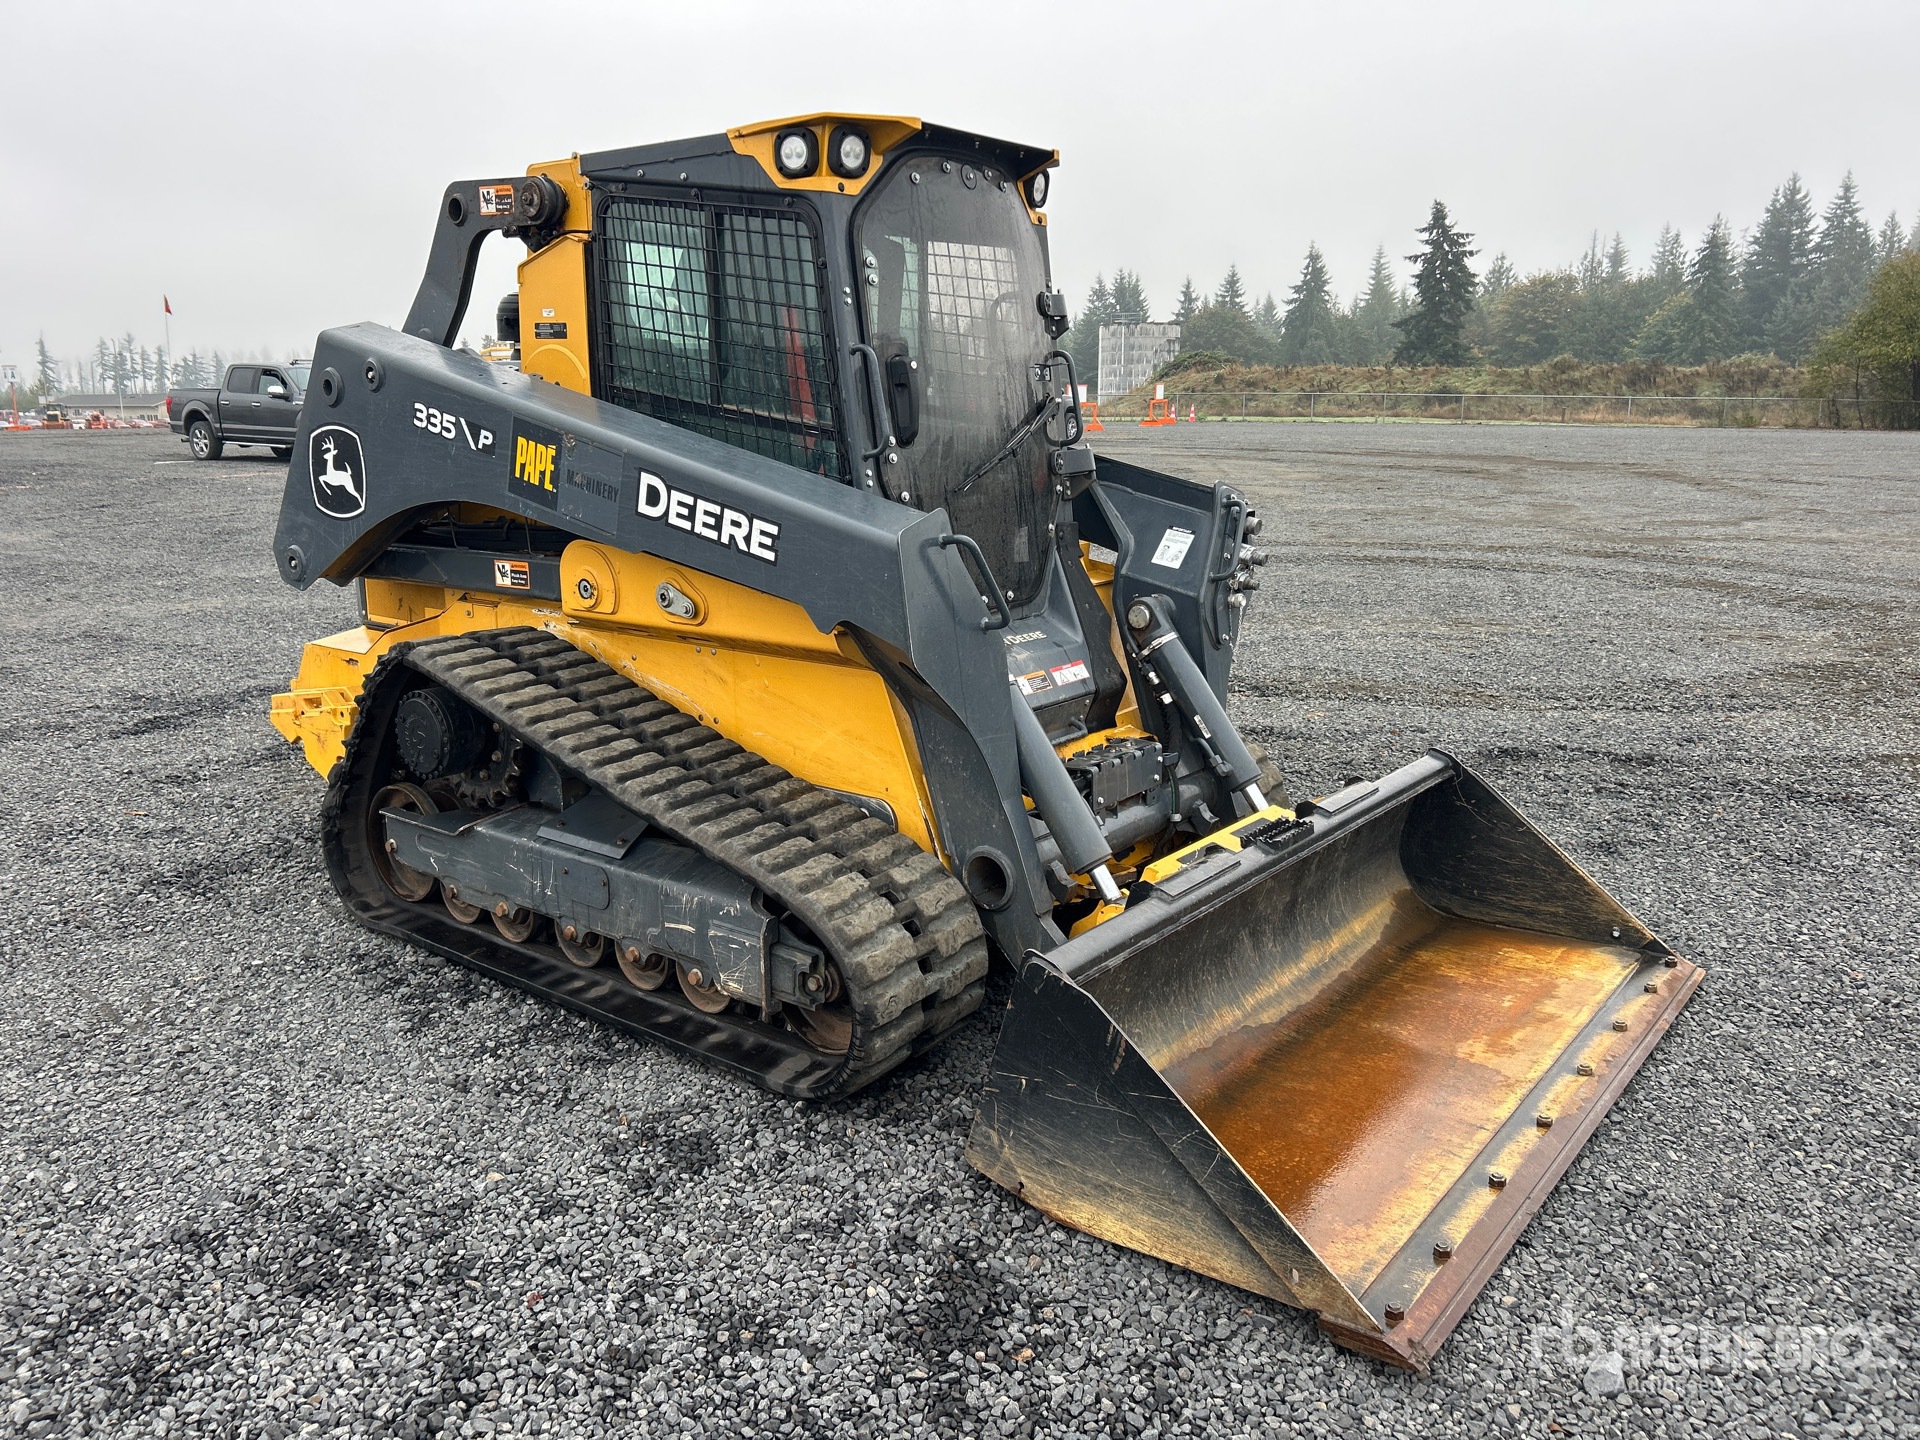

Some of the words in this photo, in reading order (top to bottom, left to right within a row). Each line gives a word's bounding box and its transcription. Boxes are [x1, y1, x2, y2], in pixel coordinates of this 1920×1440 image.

[514, 436, 557, 492] PAPÉ
[566, 468, 620, 503] MACHINERY
[638, 470, 780, 562] DEERE
[1008, 631, 1047, 644] DEERE
